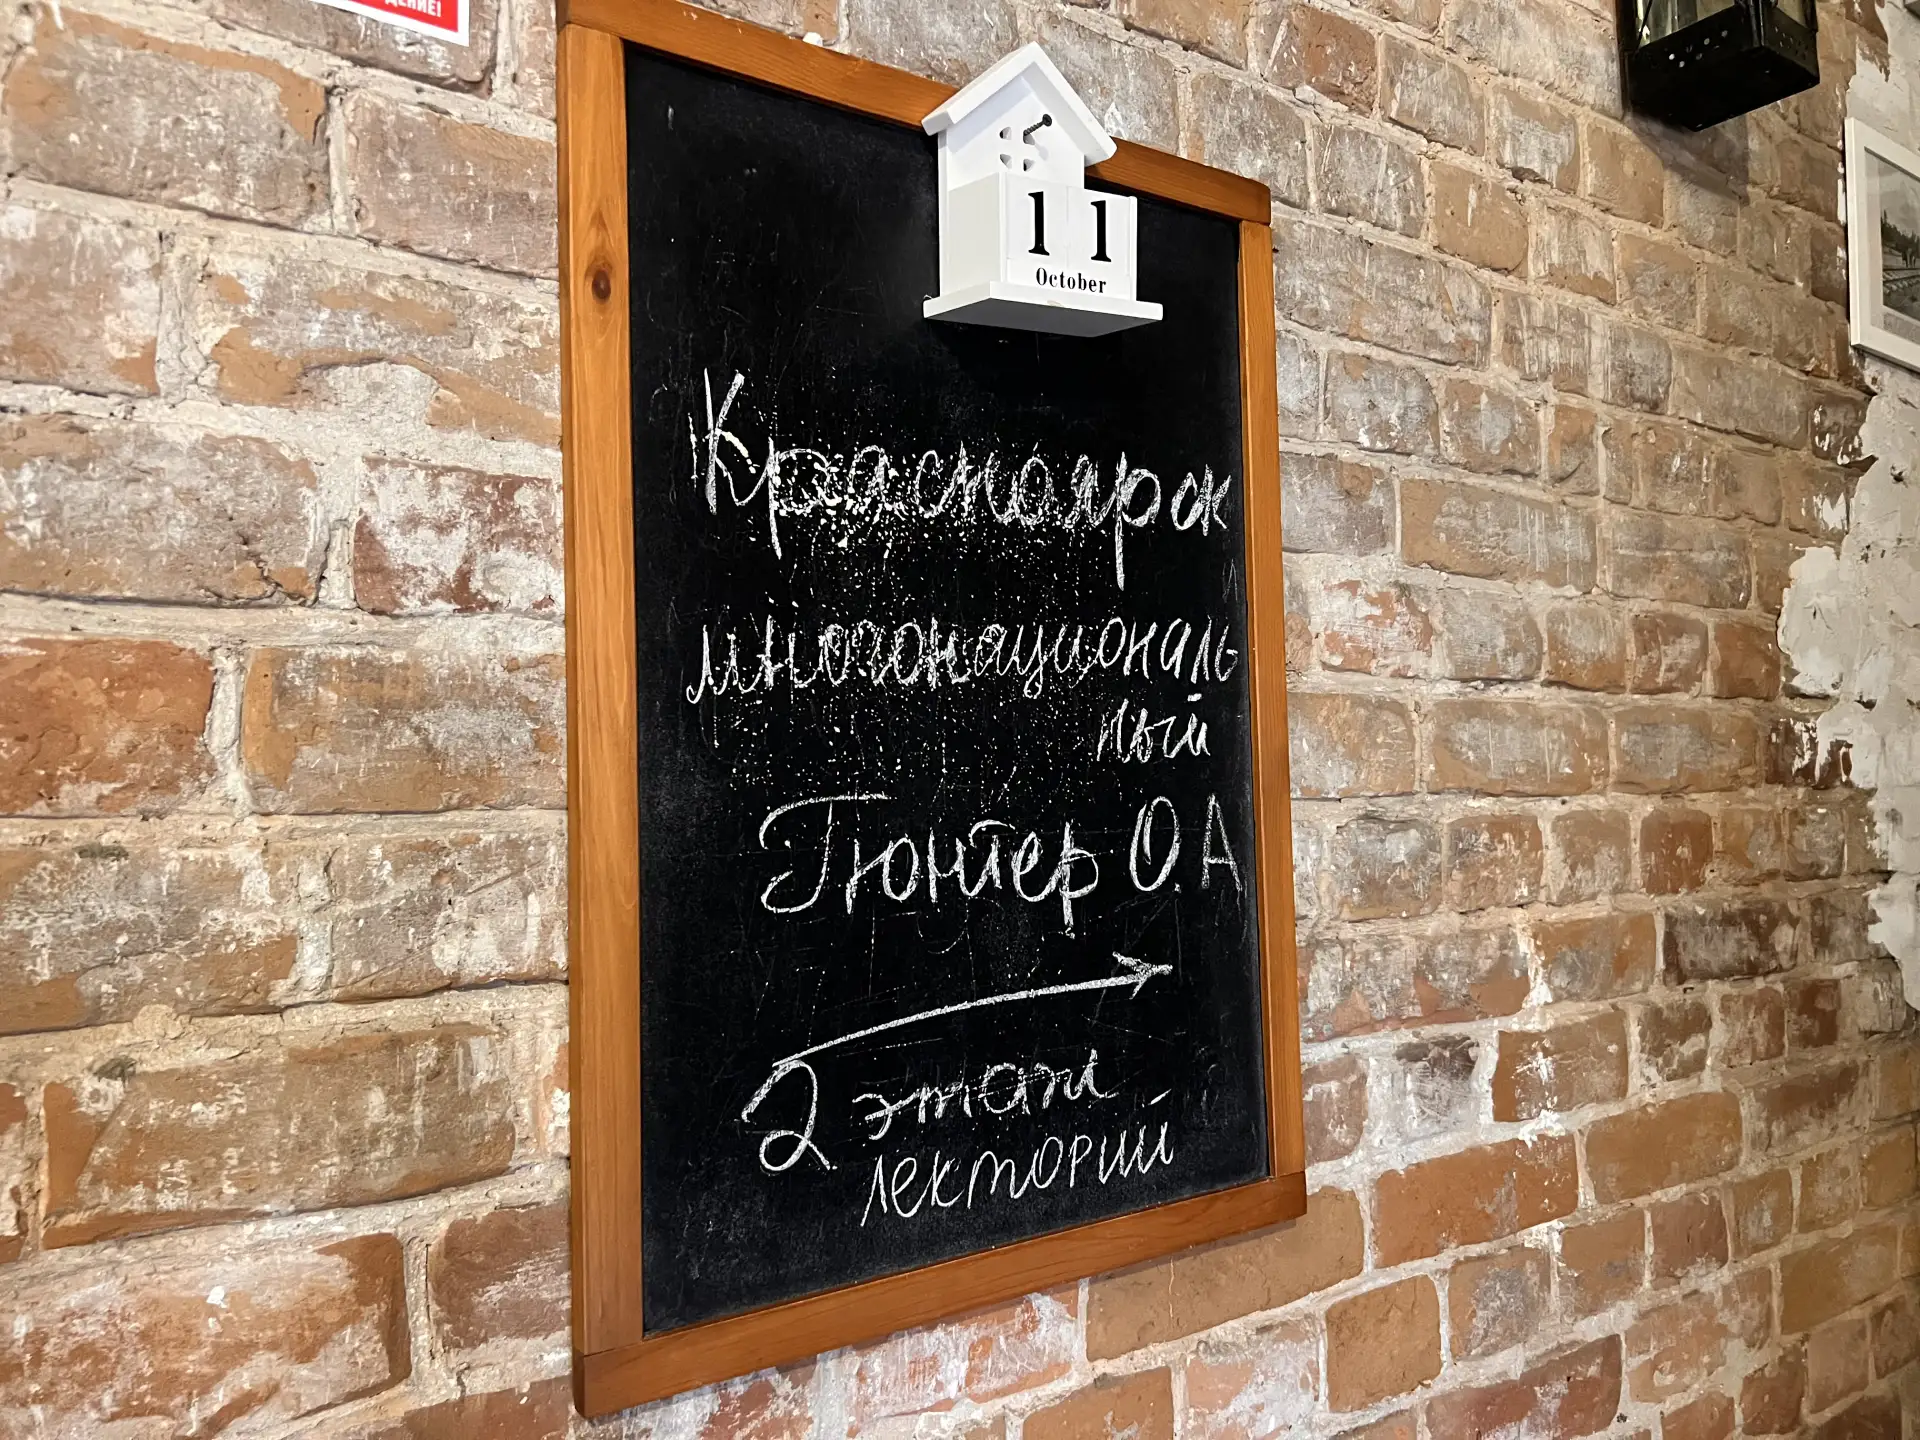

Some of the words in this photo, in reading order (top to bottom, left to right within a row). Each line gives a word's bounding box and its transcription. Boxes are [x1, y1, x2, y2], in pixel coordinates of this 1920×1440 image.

[1036, 267, 1107, 294] October
[758, 793, 1099, 936] Гюнтер
[741, 1057, 837, 1172] 2
[861, 1088, 1174, 1227] лекторий
